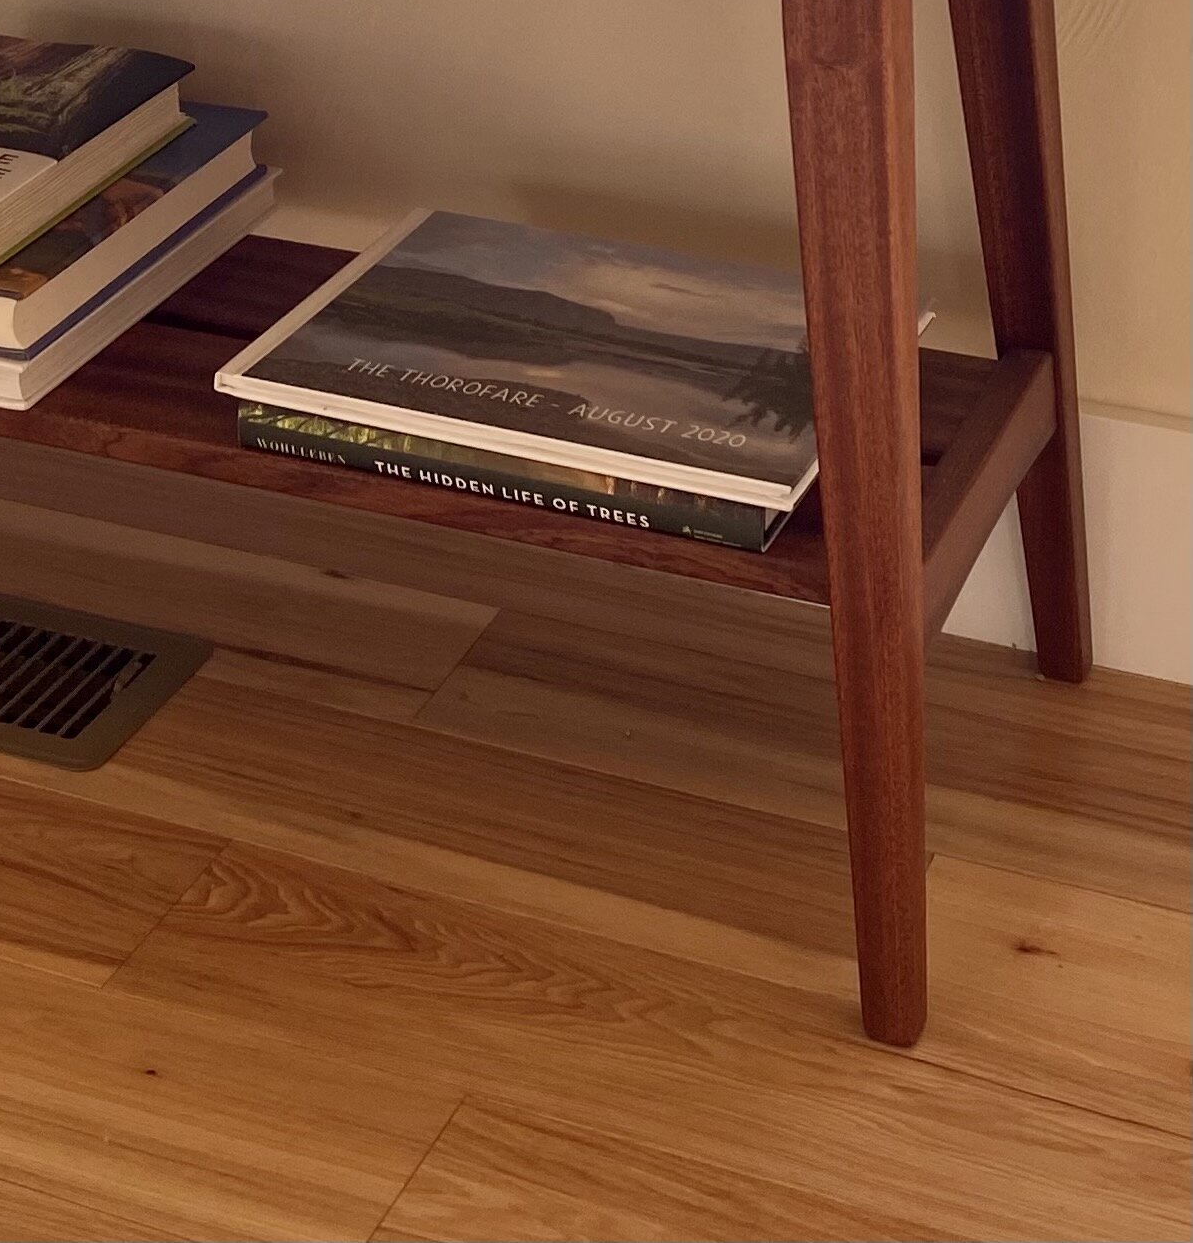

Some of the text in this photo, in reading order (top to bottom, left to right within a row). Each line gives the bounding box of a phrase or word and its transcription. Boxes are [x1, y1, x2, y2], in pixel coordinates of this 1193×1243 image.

[346, 357, 396, 378] THE
[399, 368, 545, 408] THOROFARE
[567, 403, 679, 434] AUGUST
[680, 424, 747, 448] 2020
[256, 437, 651, 529] WOHLLEBEN THE HIDDEN LIFE OF TREES
